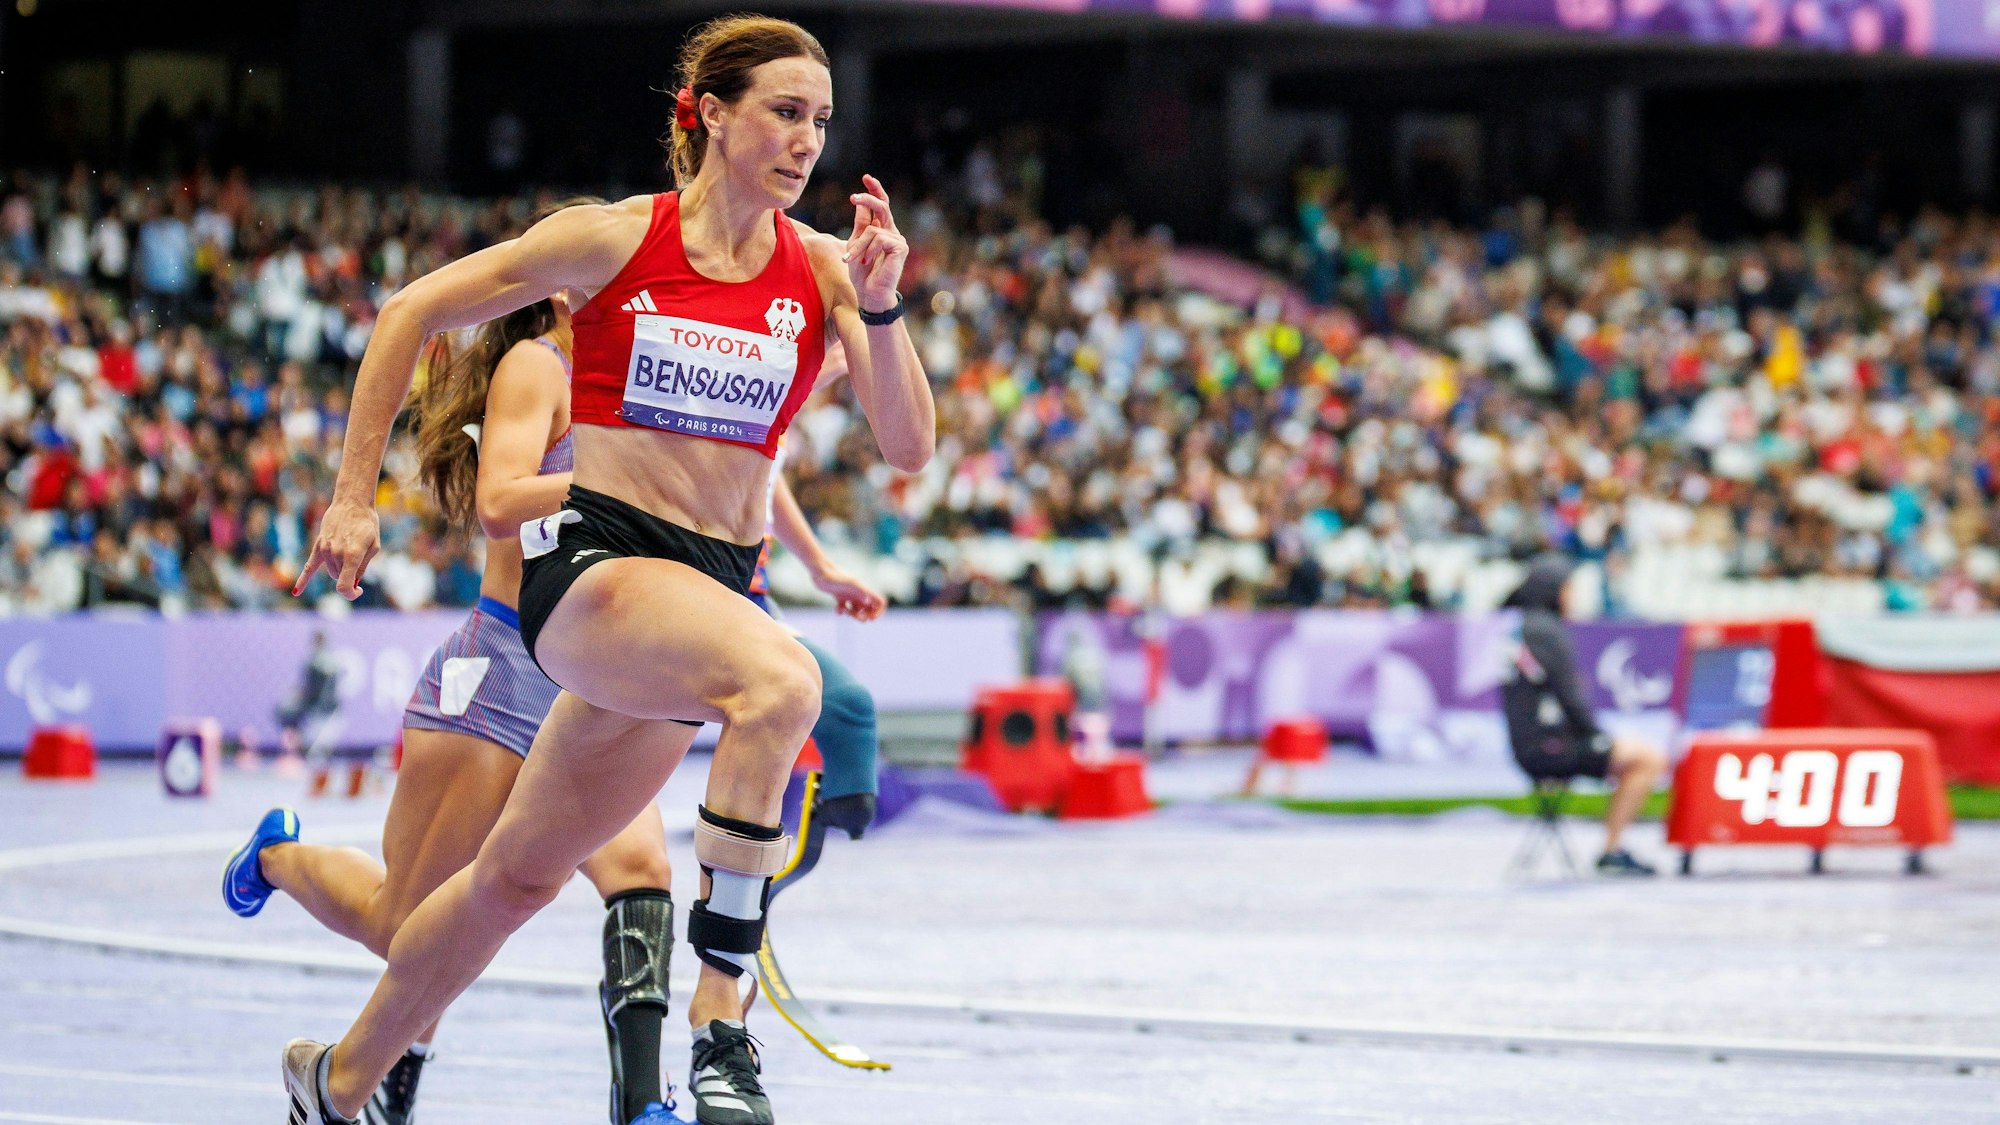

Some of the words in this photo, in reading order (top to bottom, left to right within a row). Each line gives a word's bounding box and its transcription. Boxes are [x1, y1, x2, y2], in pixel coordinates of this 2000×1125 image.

[671, 328, 762, 361] TOYOTA
[634, 354, 785, 412] BENSUSAN
[711, 424, 742, 436] 2024
[1714, 750, 1904, 826] 4:00
